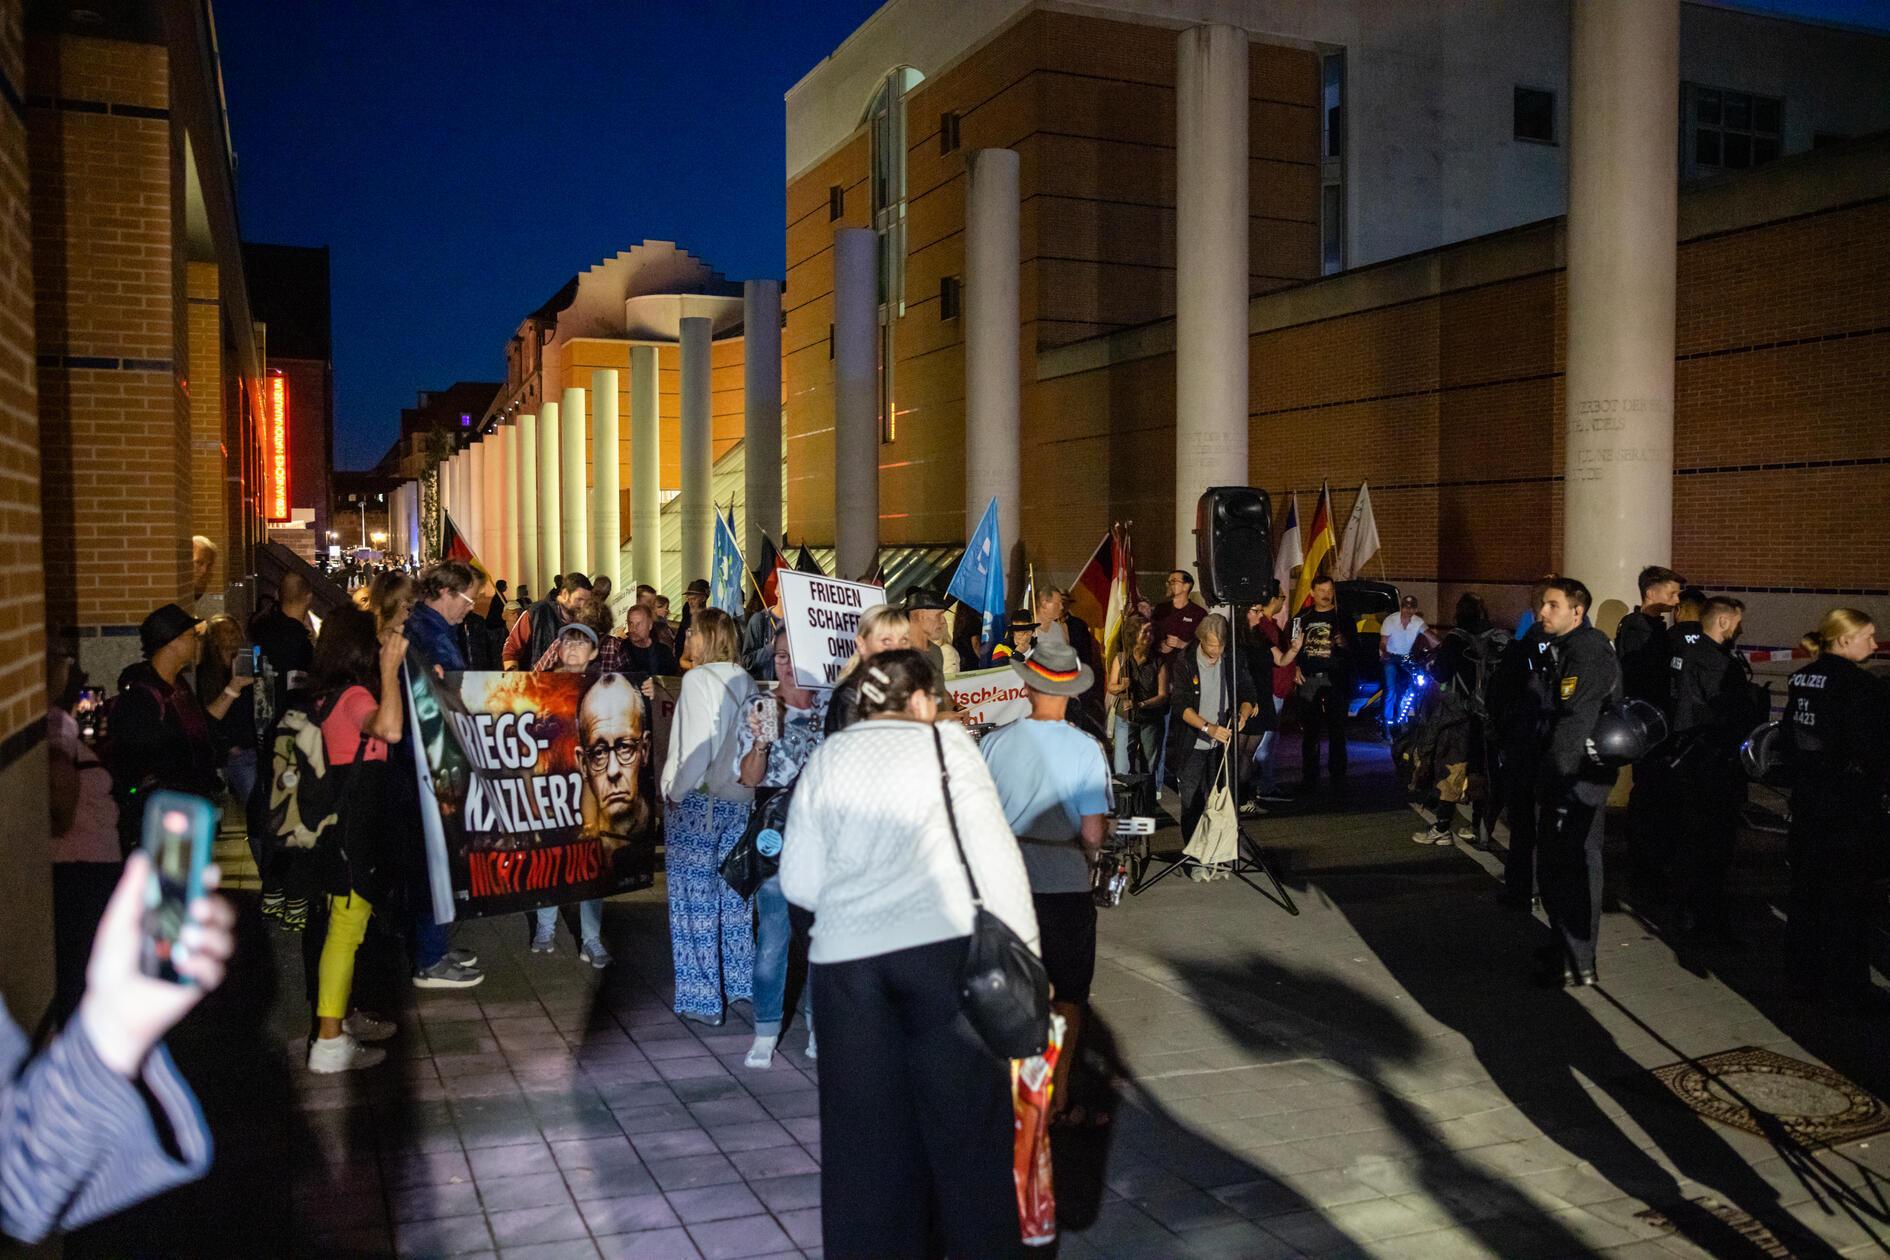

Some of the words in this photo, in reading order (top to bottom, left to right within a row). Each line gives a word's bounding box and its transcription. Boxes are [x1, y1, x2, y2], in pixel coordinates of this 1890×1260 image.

[809, 580, 862, 609] FRIEDEN
[808, 607, 861, 634] SCHAFF
[450, 711, 549, 770] RIEGS-
[469, 849, 527, 897] NICHT
[525, 845, 563, 892] MIT
